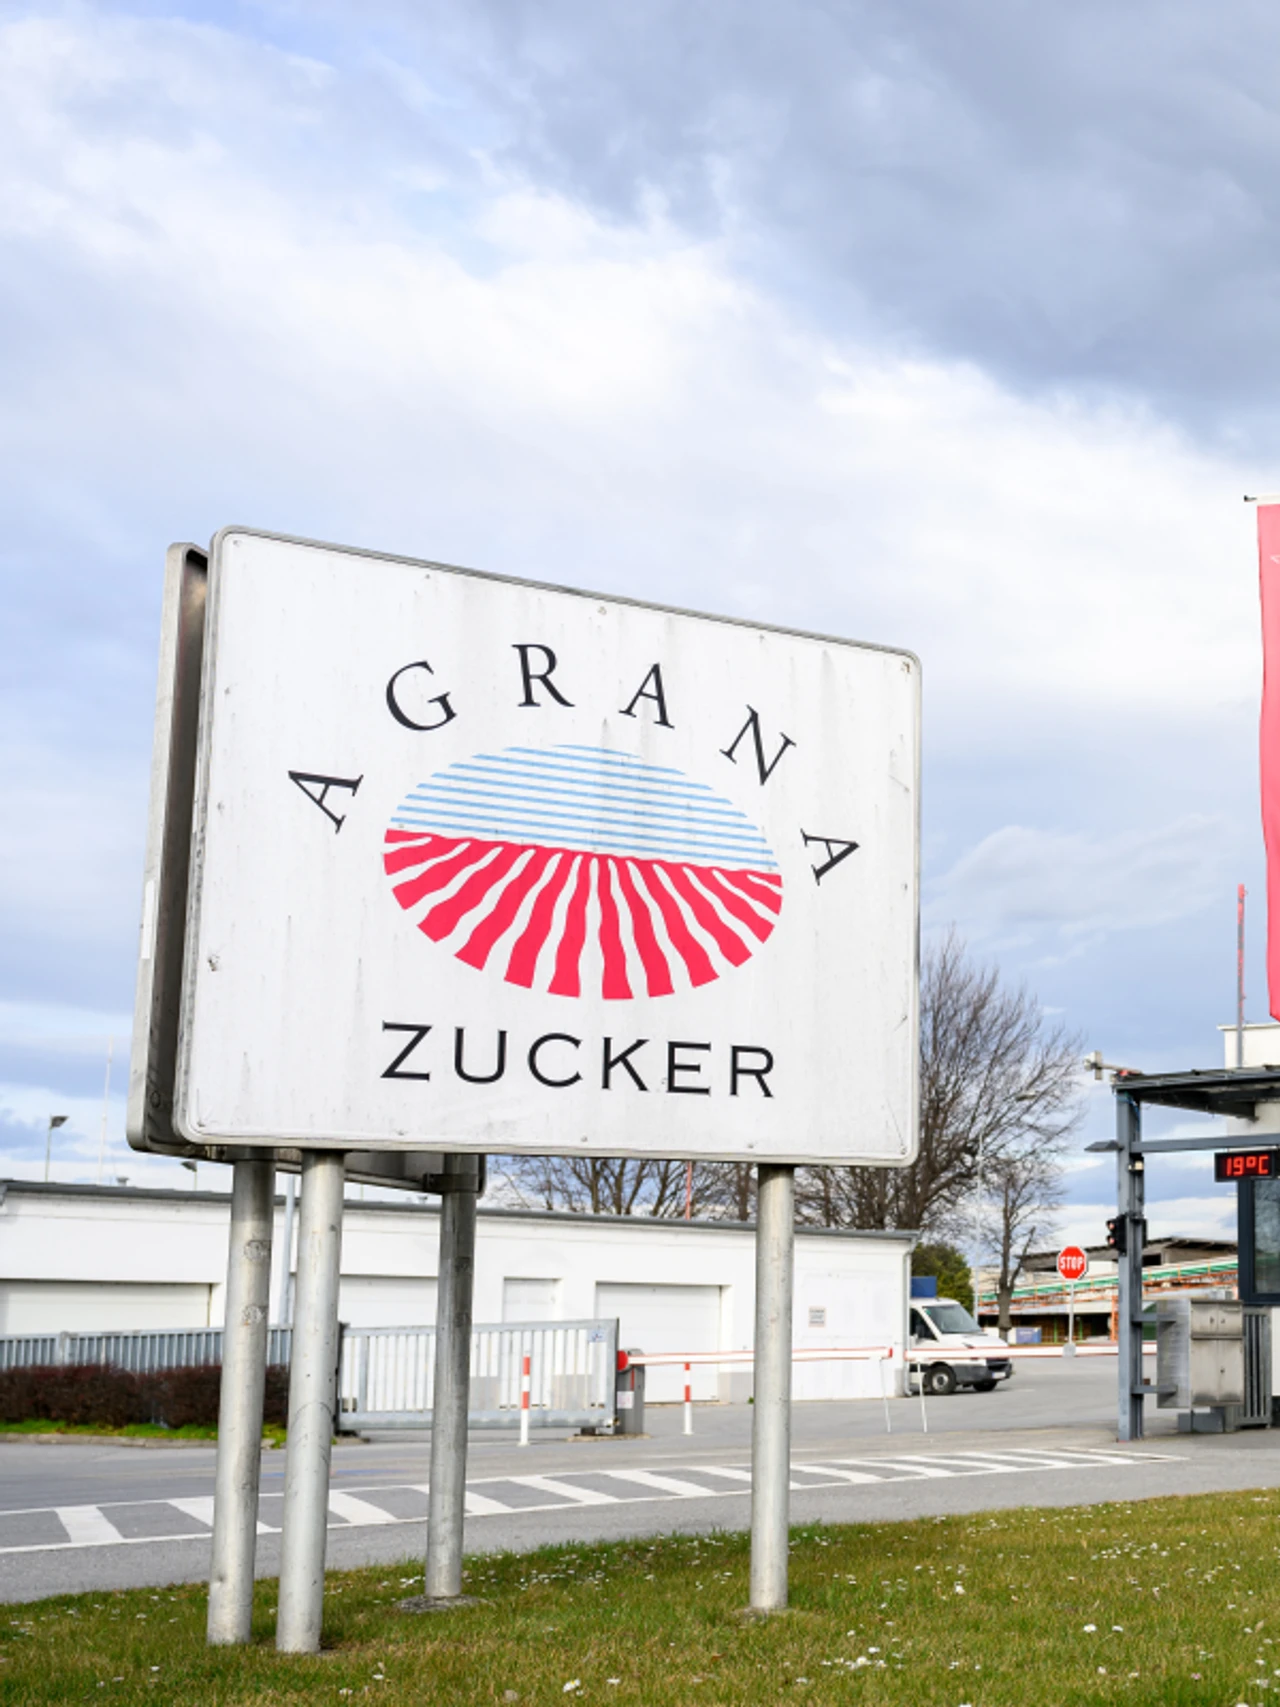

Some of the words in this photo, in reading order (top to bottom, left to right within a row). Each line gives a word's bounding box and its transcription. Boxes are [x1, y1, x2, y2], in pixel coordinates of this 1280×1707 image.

[288, 643, 861, 886] AGRANA
[379, 1020, 775, 1098] ZUCKER
[1060, 1255, 1084, 1270] STOP
